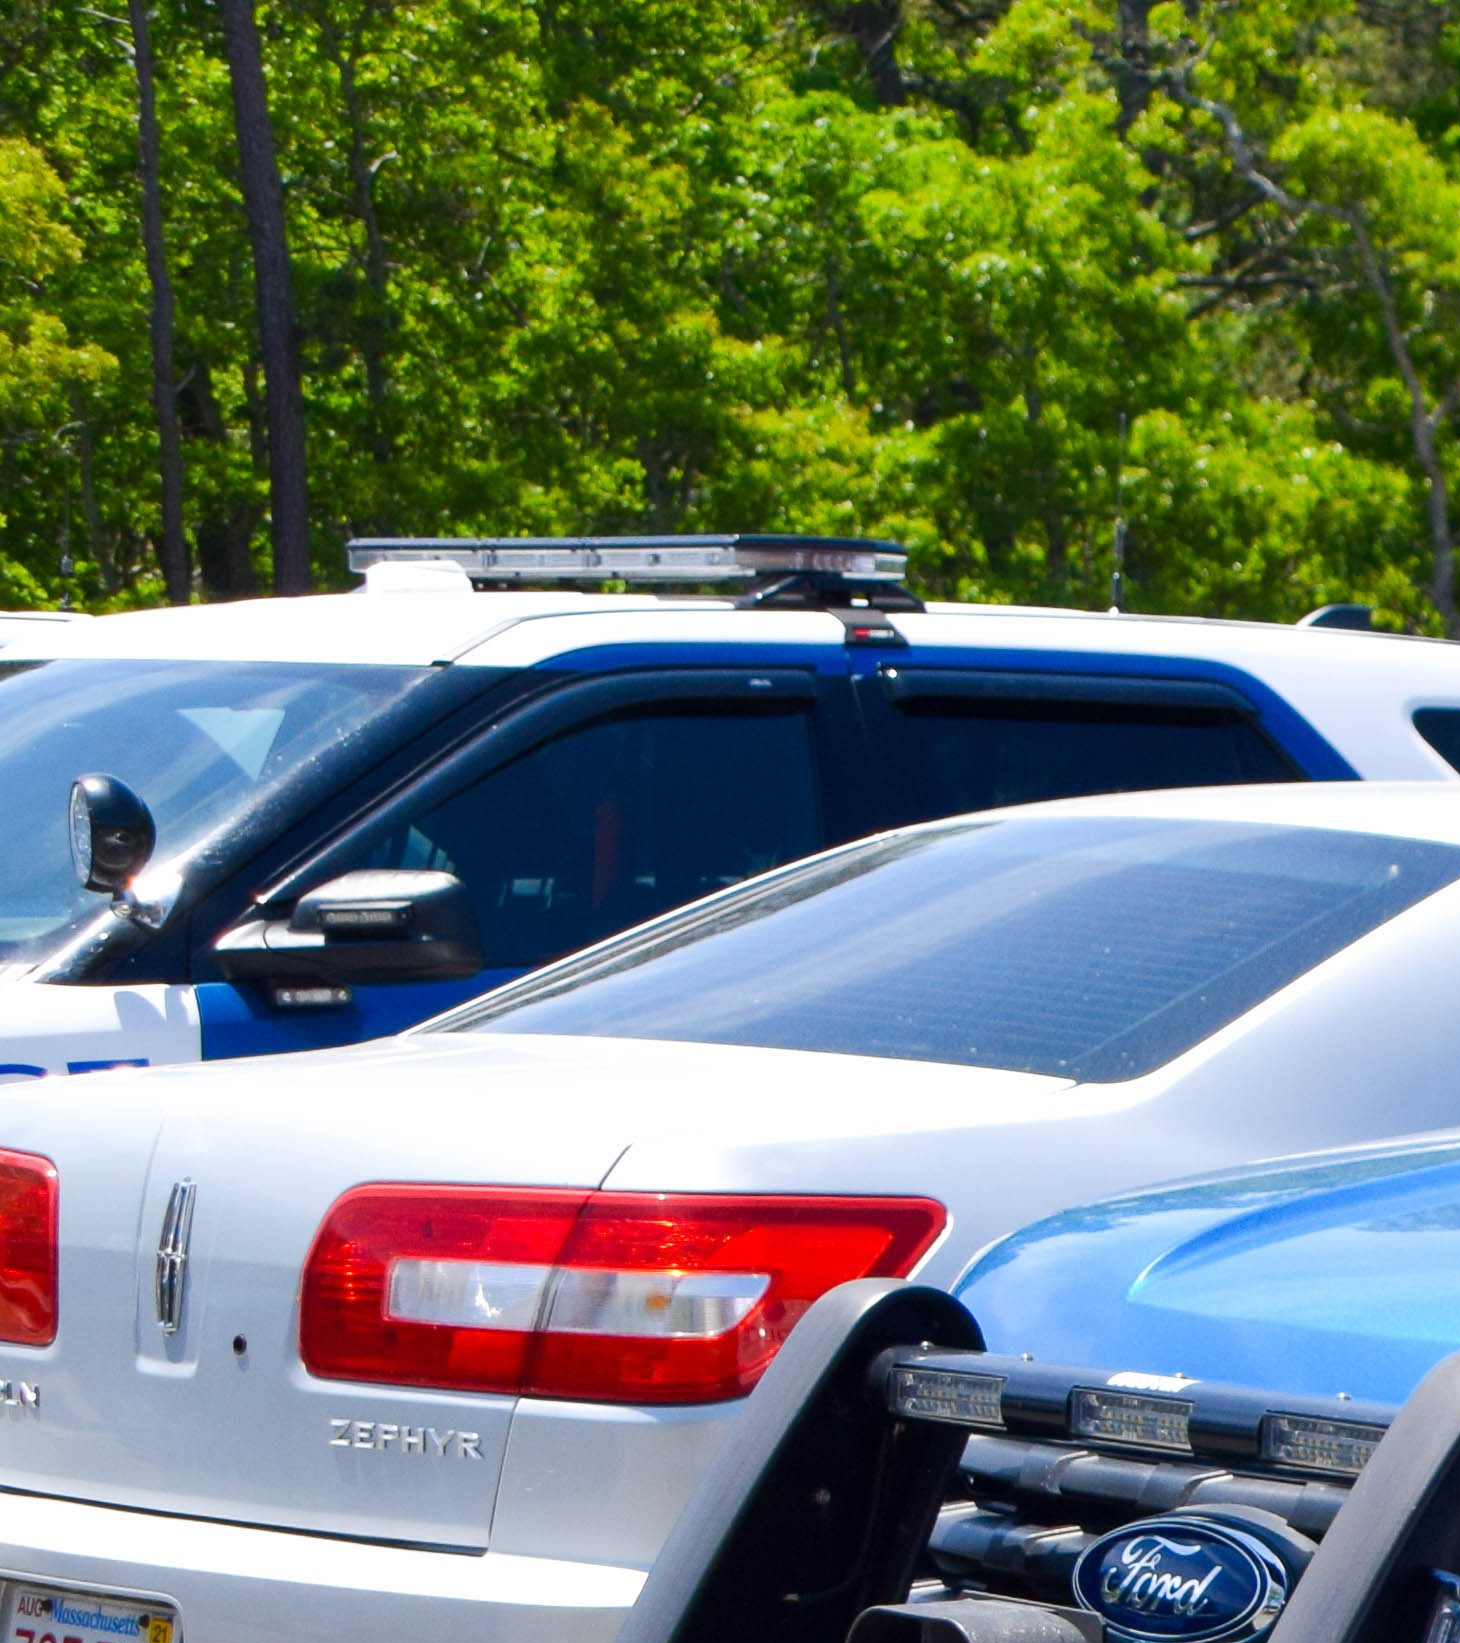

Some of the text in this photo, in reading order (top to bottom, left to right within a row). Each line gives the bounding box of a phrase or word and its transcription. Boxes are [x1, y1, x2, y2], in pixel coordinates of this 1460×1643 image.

[328, 1418, 484, 1460] ZEPHYR
[1103, 1535, 1222, 1616] Ford
[50, 1600, 141, 1637] Massachusetts
[152, 1624, 168, 1643] 21
